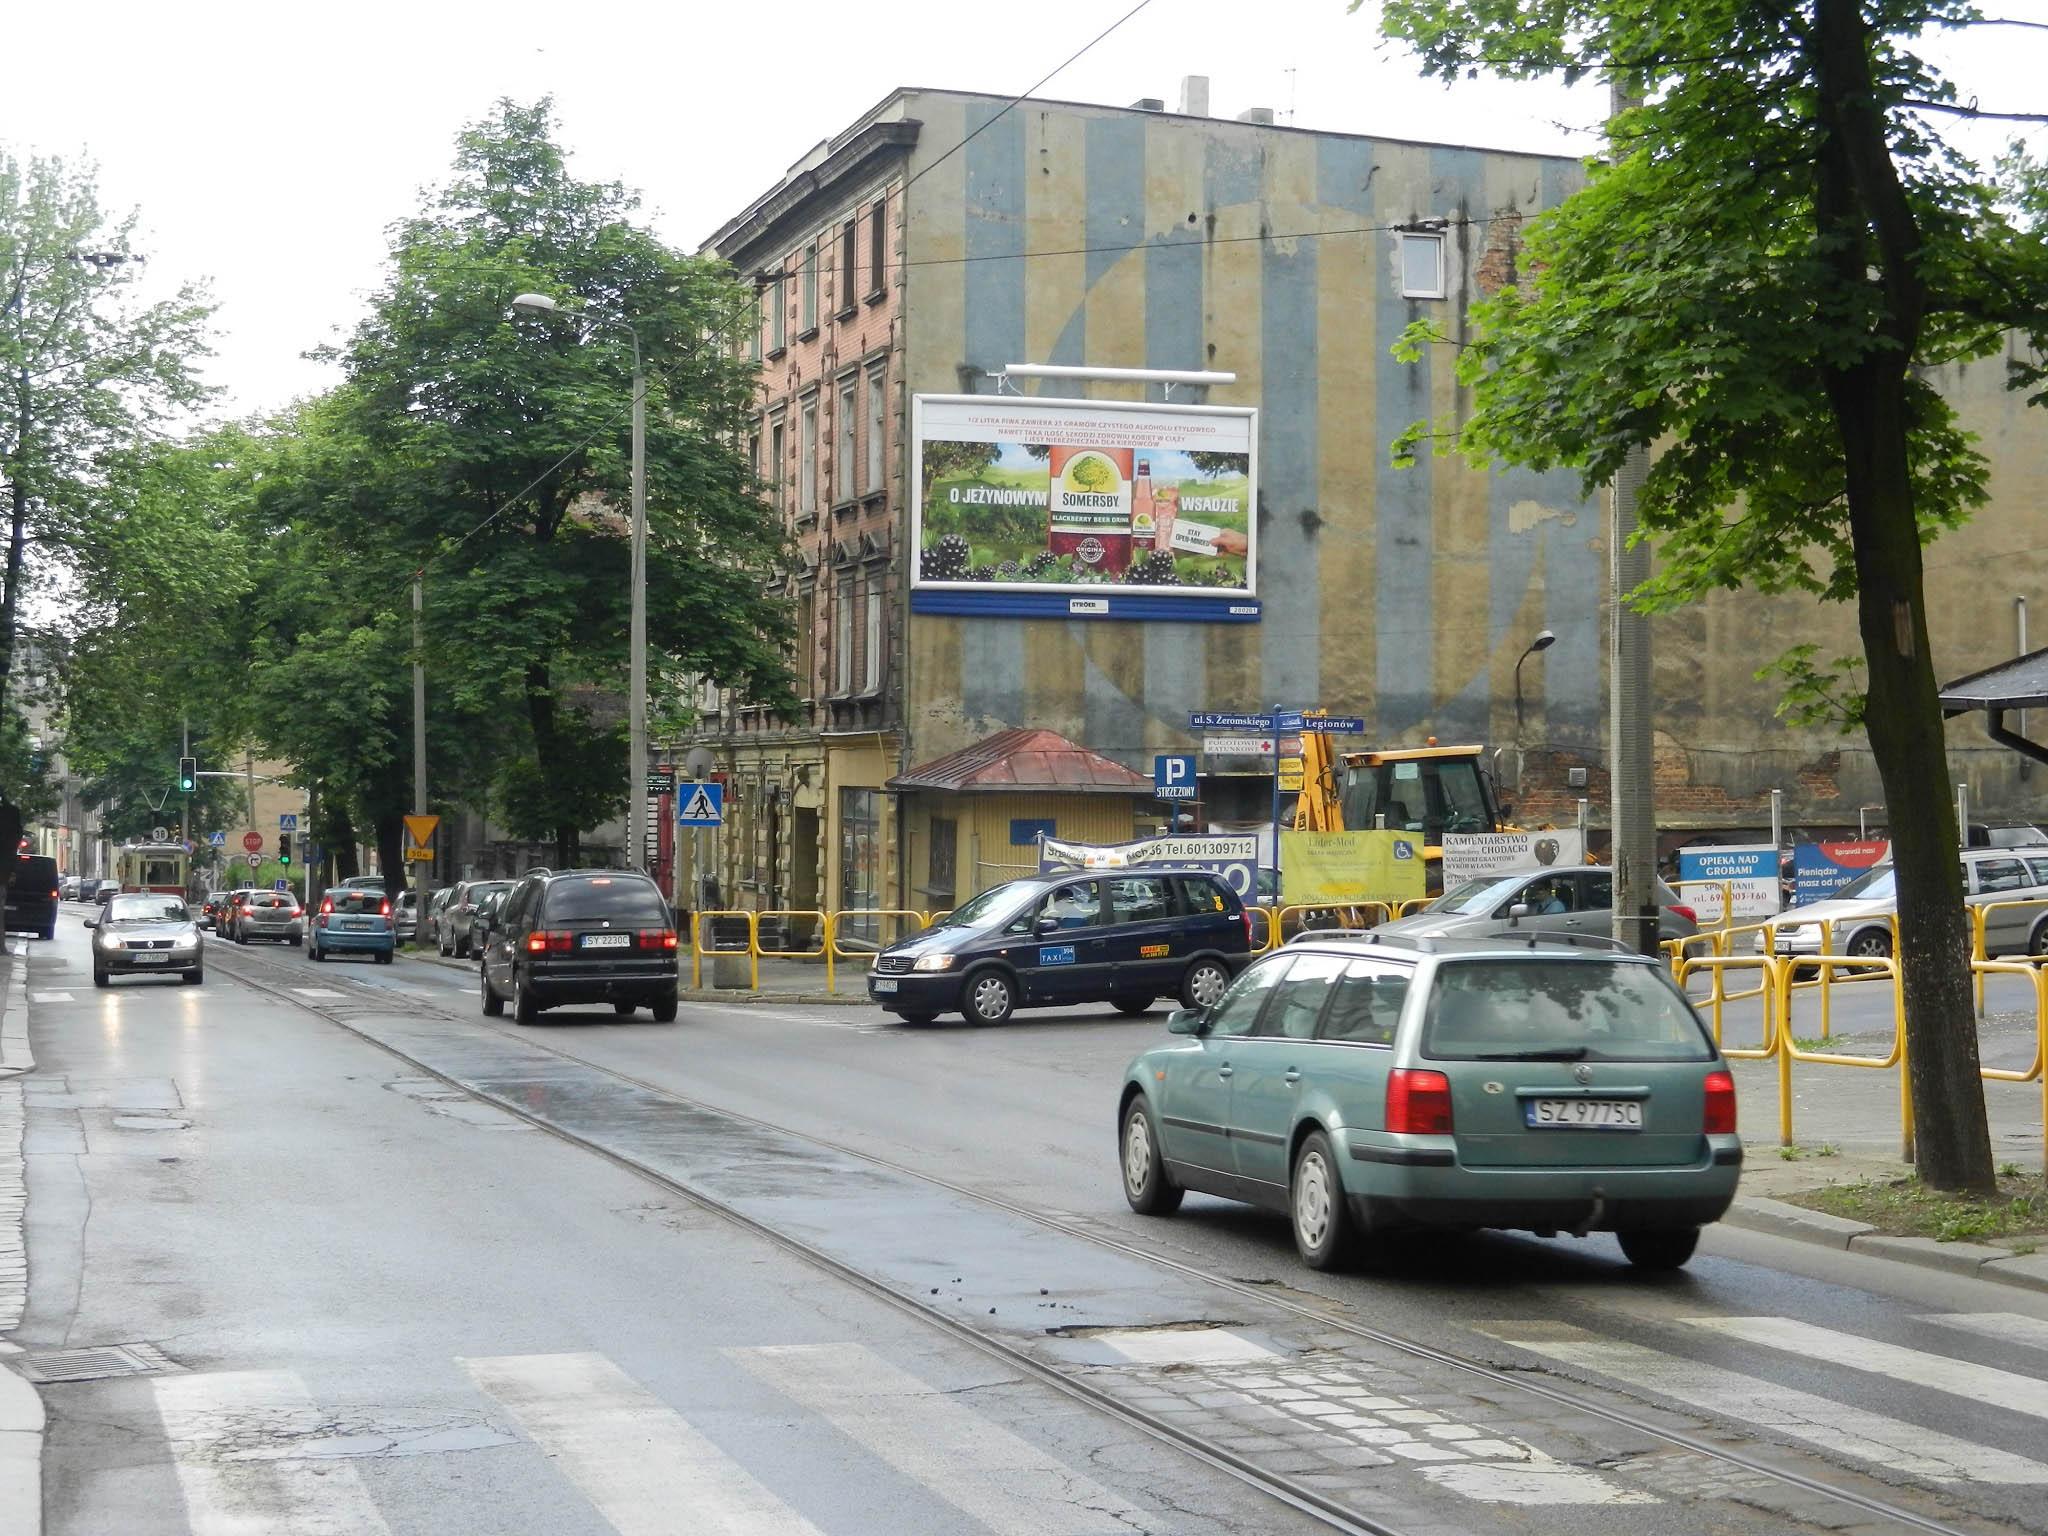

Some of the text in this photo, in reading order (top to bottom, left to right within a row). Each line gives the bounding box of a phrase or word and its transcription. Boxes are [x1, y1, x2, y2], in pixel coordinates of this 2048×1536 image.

[1136, 424, 1173, 432] ALKOHOLU
[950, 486, 1048, 506] O JEŻYNOWYM
[1062, 492, 1118, 508] SOMERSBY
[1181, 496, 1240, 512] WSADZIE
[1052, 514, 1092, 522] BLACKBERRY
[1216, 716, 1270, 729] Żeromskiego
[1306, 720, 1355, 730] Legionów
[1166, 758, 1186, 784] P
[245, 838, 261, 846] STOP
[1446, 835, 1528, 846] KAMIENIARSTWO
[1166, 842, 1252, 856] Tel.601309712
[1482, 844, 1528, 854] CHODACKI
[1700, 855, 1759, 866] OPIEKA NAD
[1706, 866, 1752, 876] GROBAMI
[1798, 868, 1838, 878] Pieniądze
[278, 880, 286, 889] L
[587, 936, 628, 944] SY 2230C
[1539, 1101, 1638, 1124] SZ 9775C
